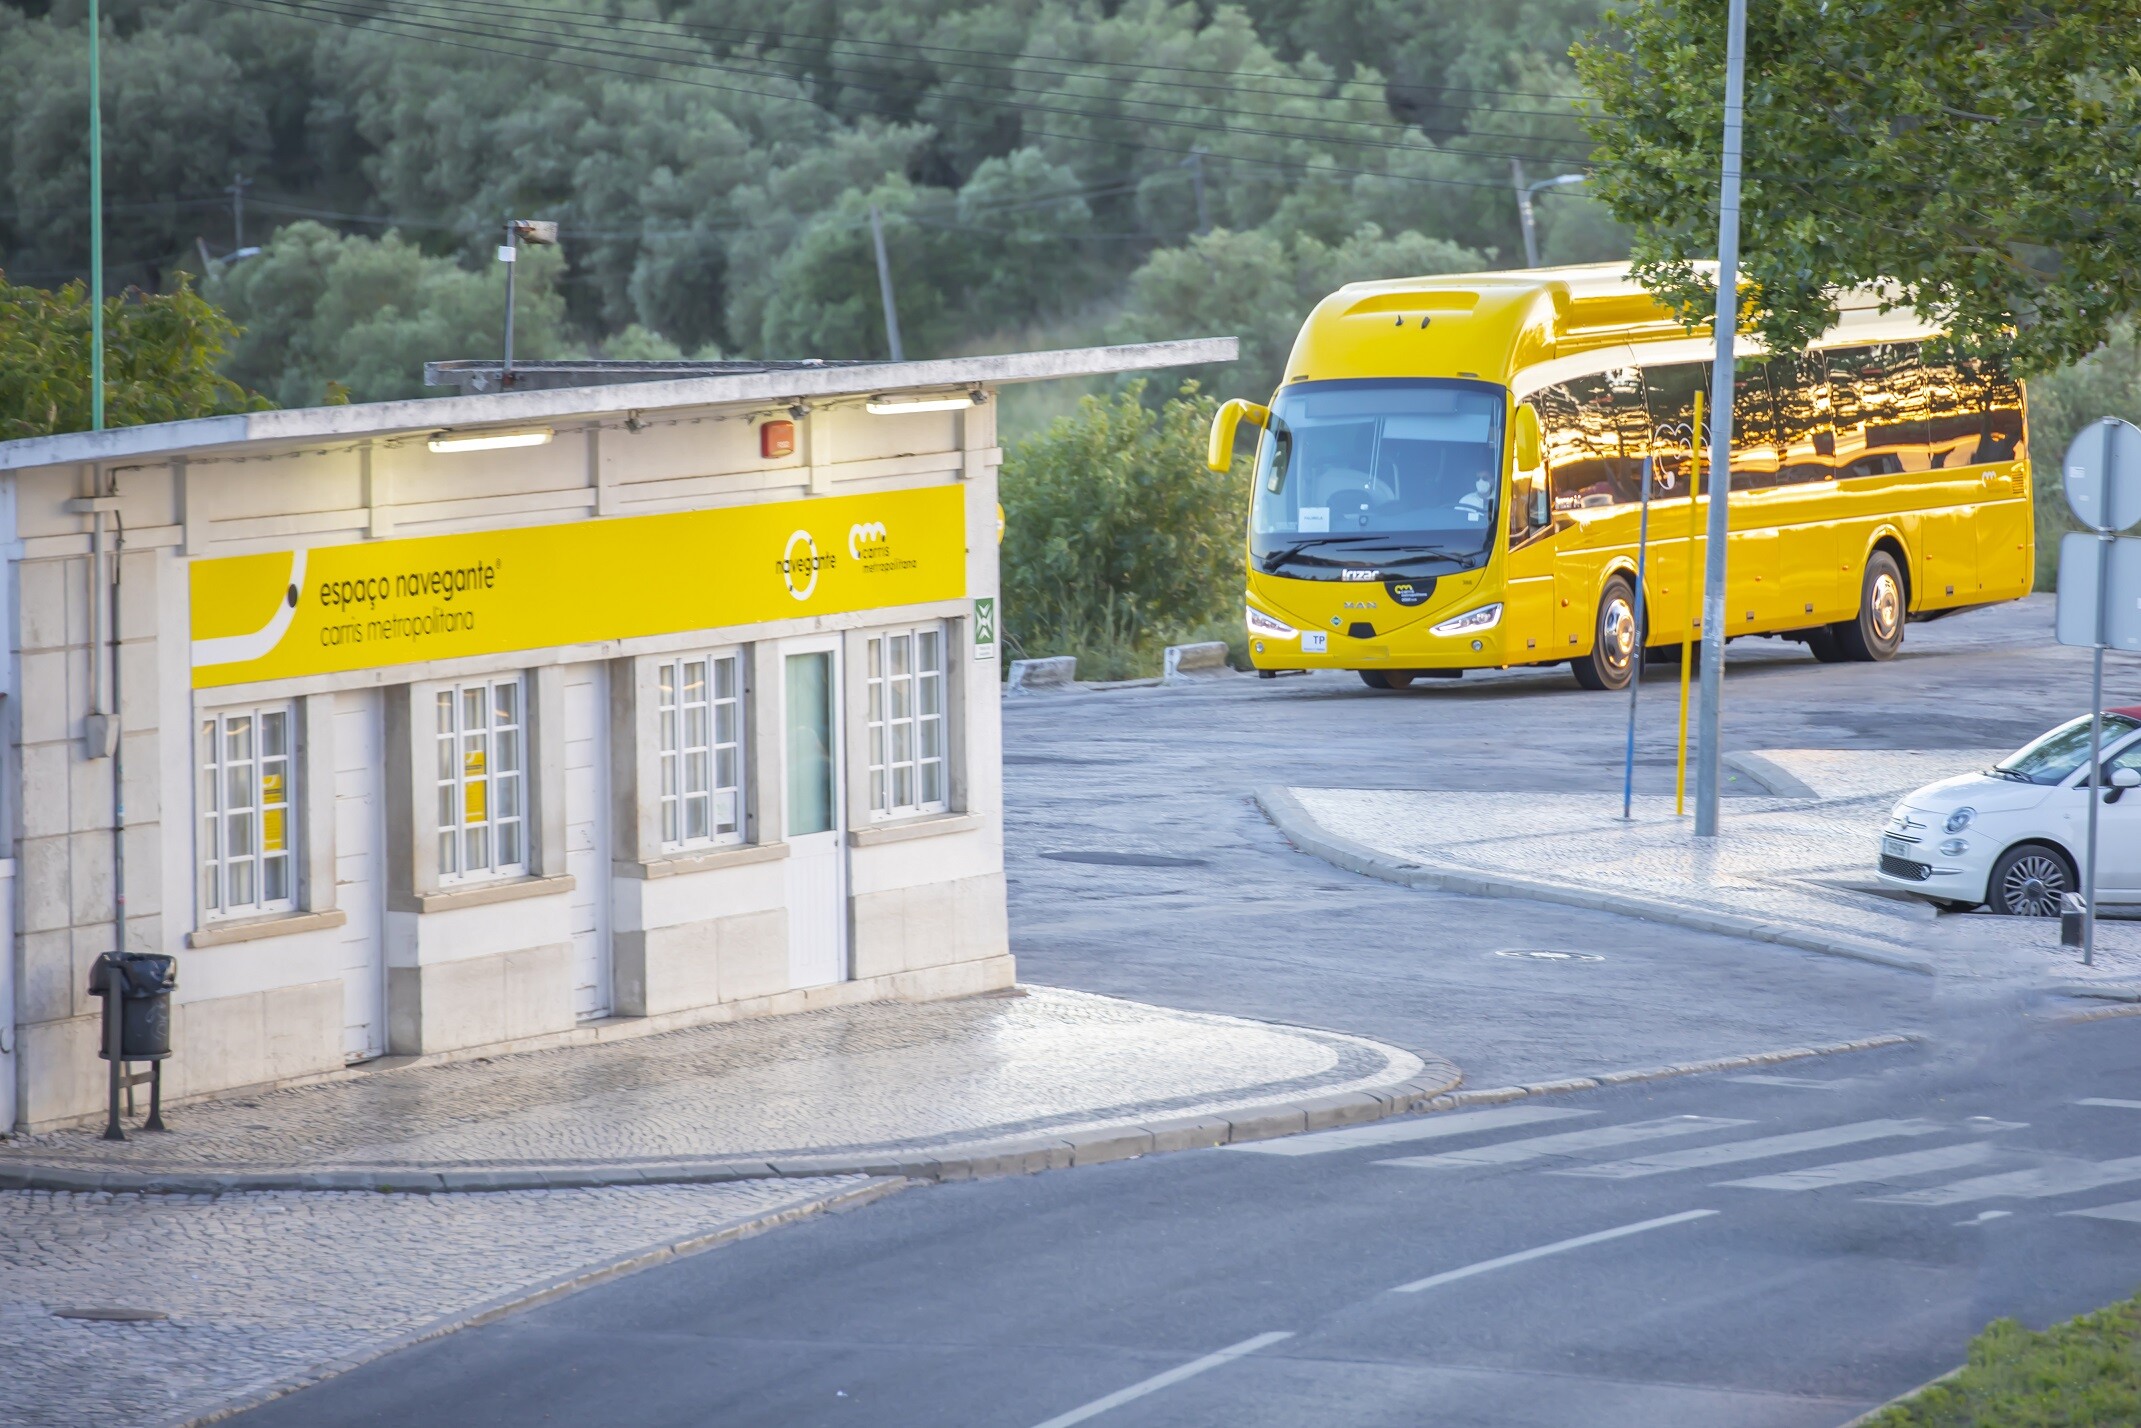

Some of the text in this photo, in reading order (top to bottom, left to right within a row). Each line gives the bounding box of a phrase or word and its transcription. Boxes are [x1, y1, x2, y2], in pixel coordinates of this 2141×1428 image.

[863, 545, 890, 559] carris
[775, 551, 836, 577] navegante
[862, 557, 917, 574] metropolitana
[320, 576, 390, 612] espaço
[1343, 601, 1378, 610] MAN
[320, 605, 475, 646] carris metropolitana
[1313, 635, 1326, 645] TP
